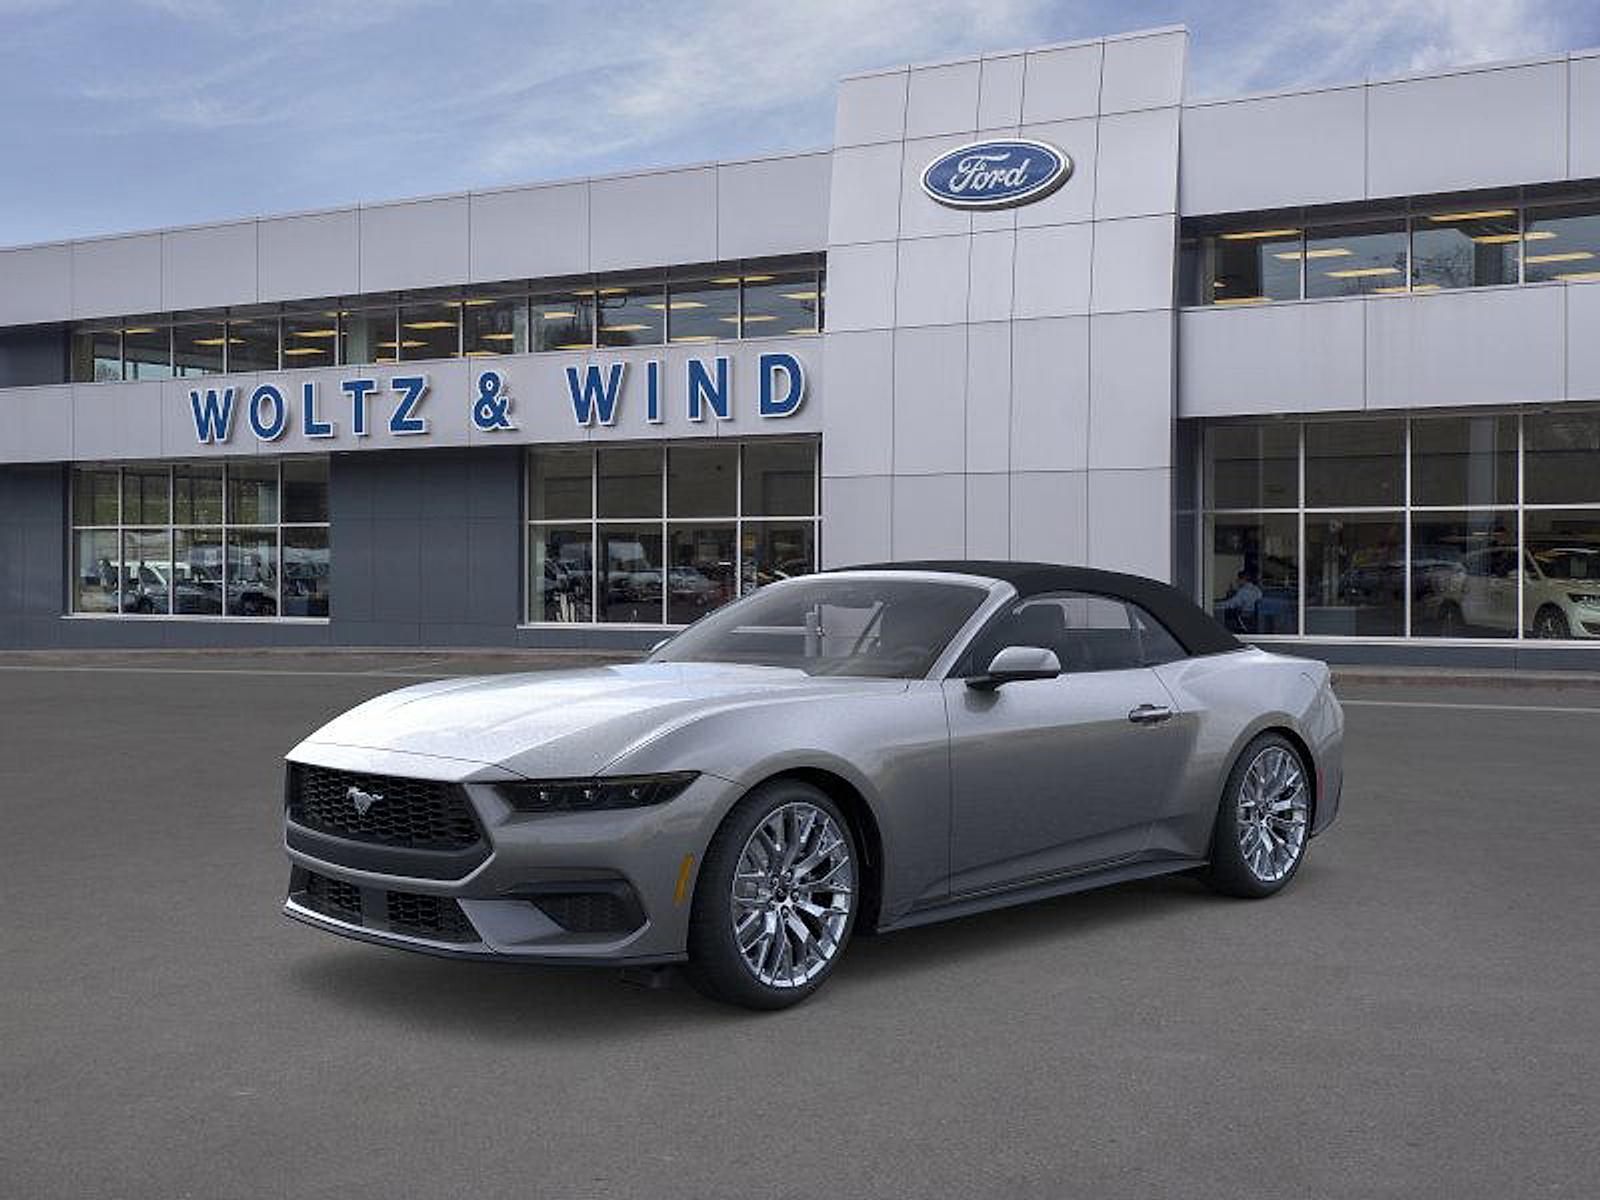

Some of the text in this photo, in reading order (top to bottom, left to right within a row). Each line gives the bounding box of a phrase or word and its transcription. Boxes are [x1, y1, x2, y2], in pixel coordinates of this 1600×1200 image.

[950, 152, 1030, 193] Ford
[190, 352, 806, 443] WOLTZ & WIND
